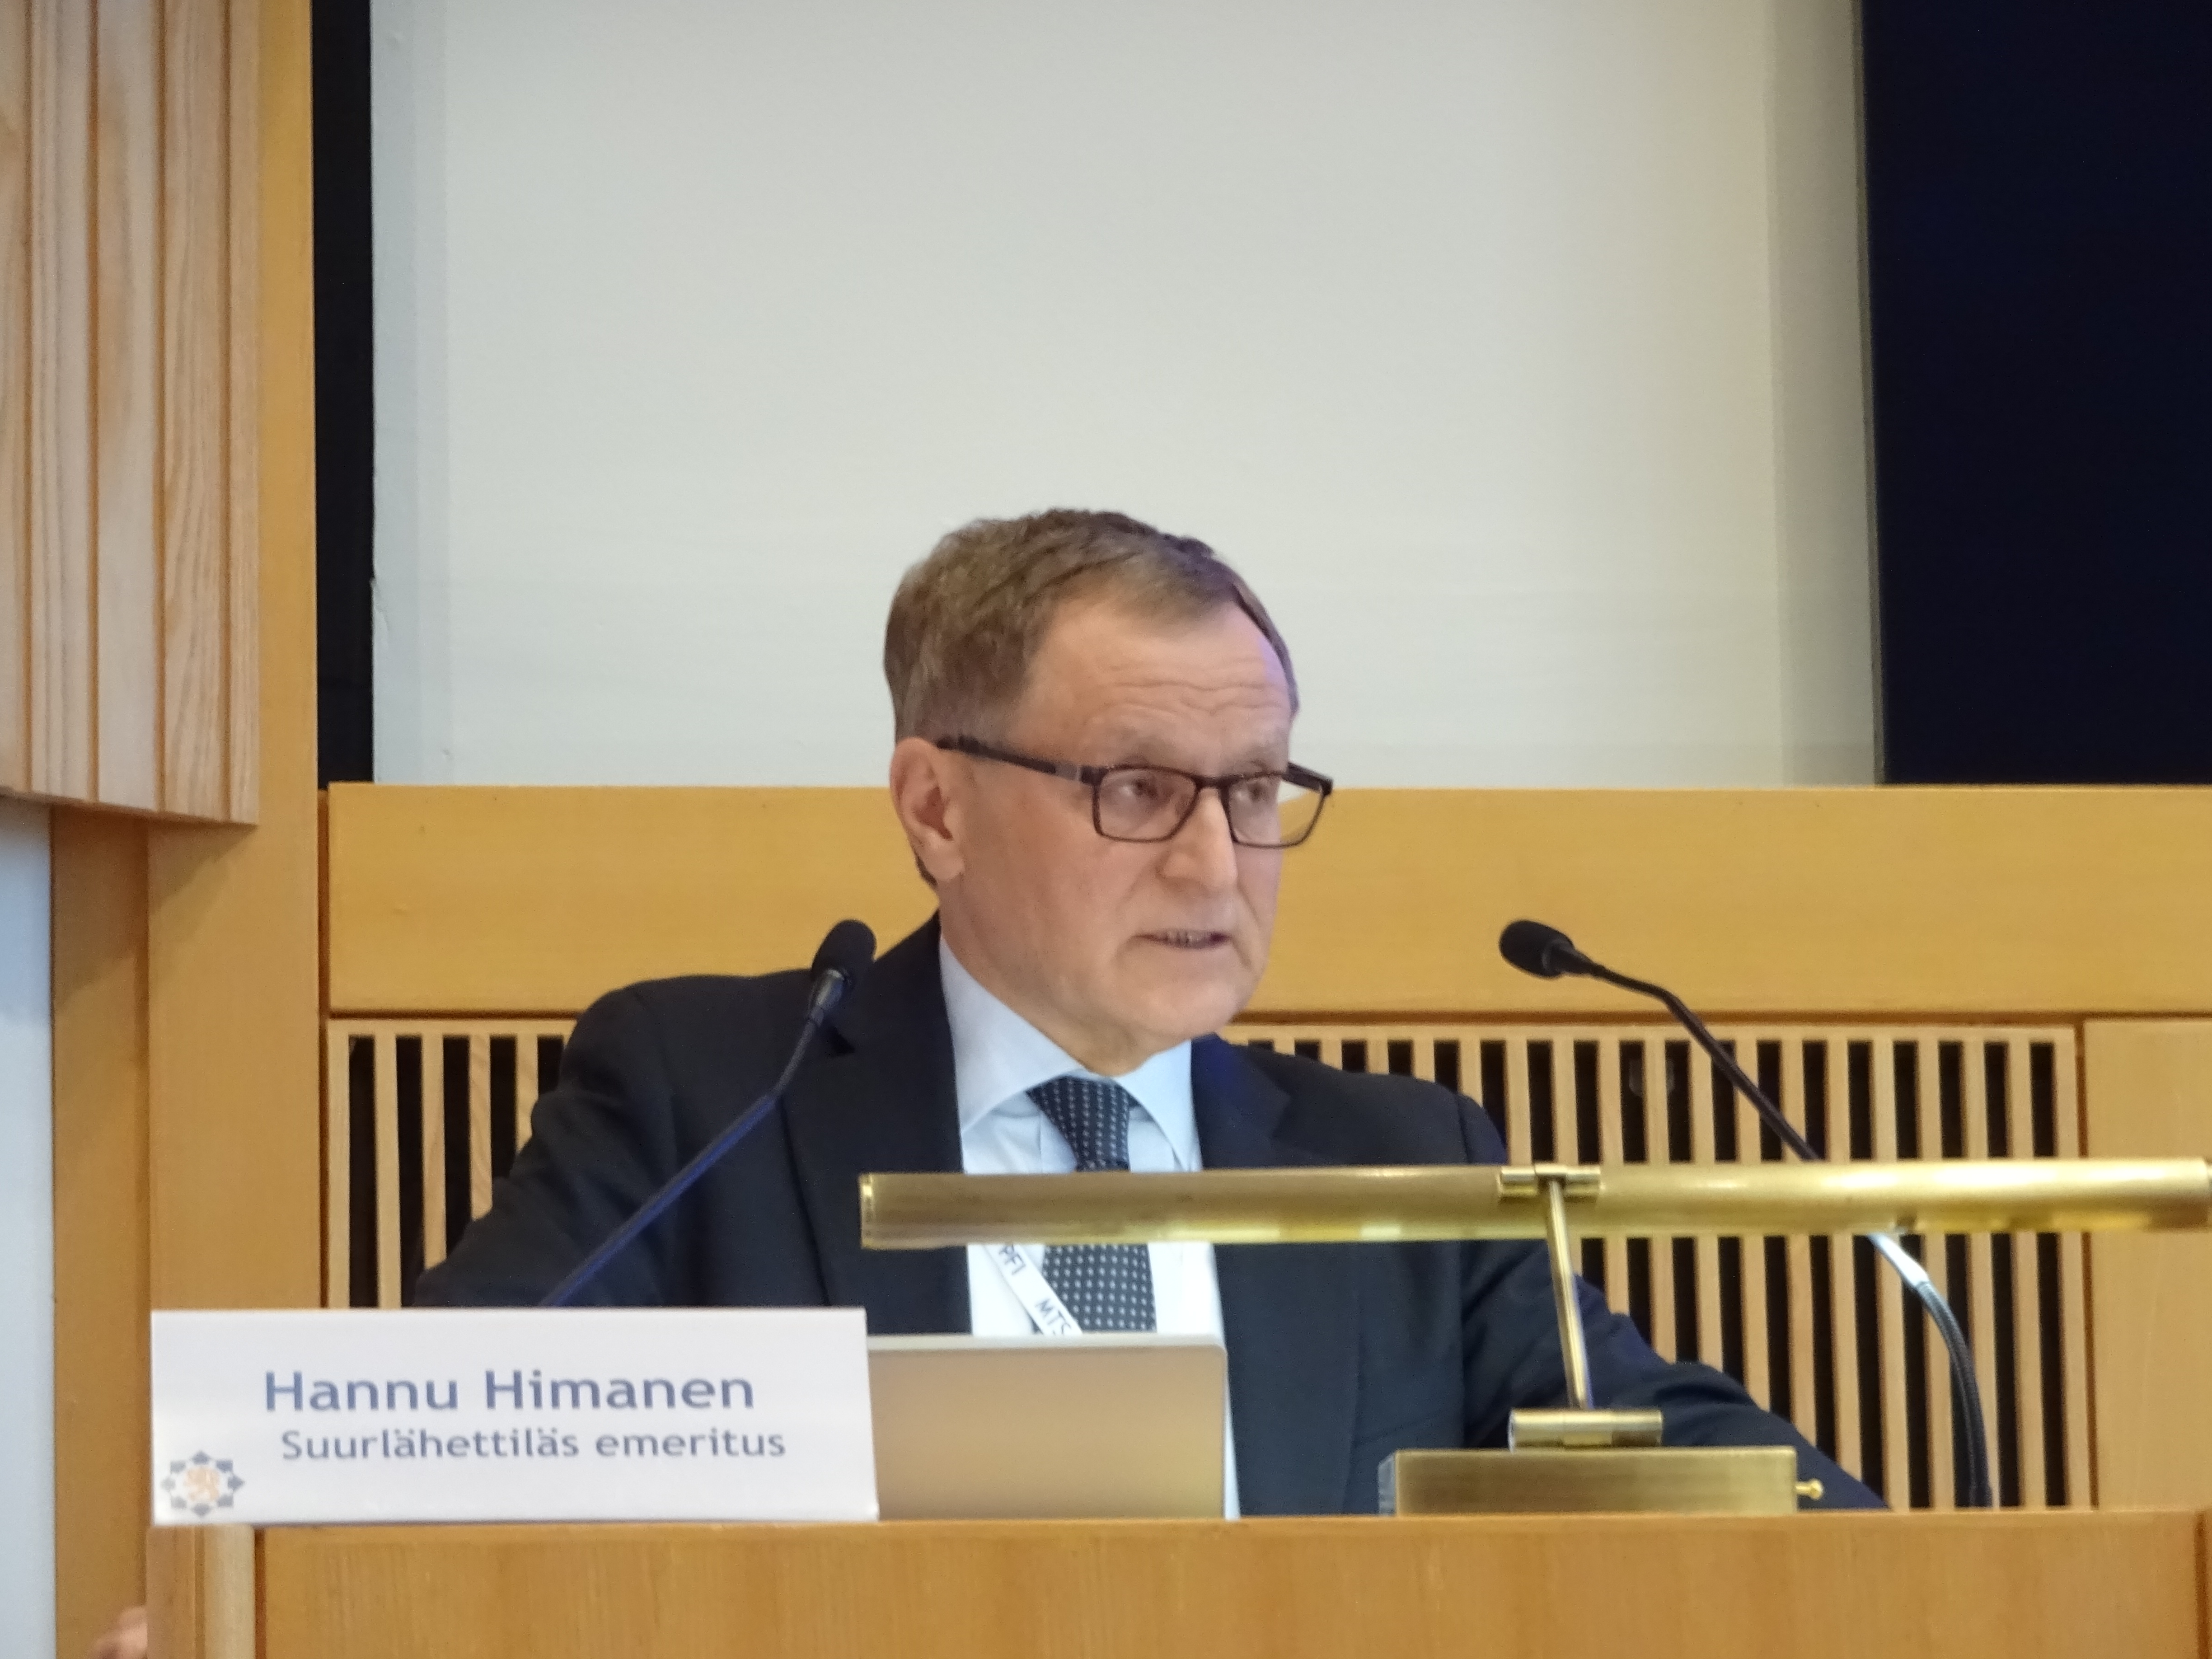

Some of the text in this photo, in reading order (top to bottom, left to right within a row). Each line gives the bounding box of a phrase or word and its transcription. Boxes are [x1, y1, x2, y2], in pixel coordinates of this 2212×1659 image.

[1034, 1298, 1072, 1335] MTS
[265, 1369, 754, 1412] Hannu Himanen
[281, 1427, 786, 1461] Suurlähettiläs emeritus
